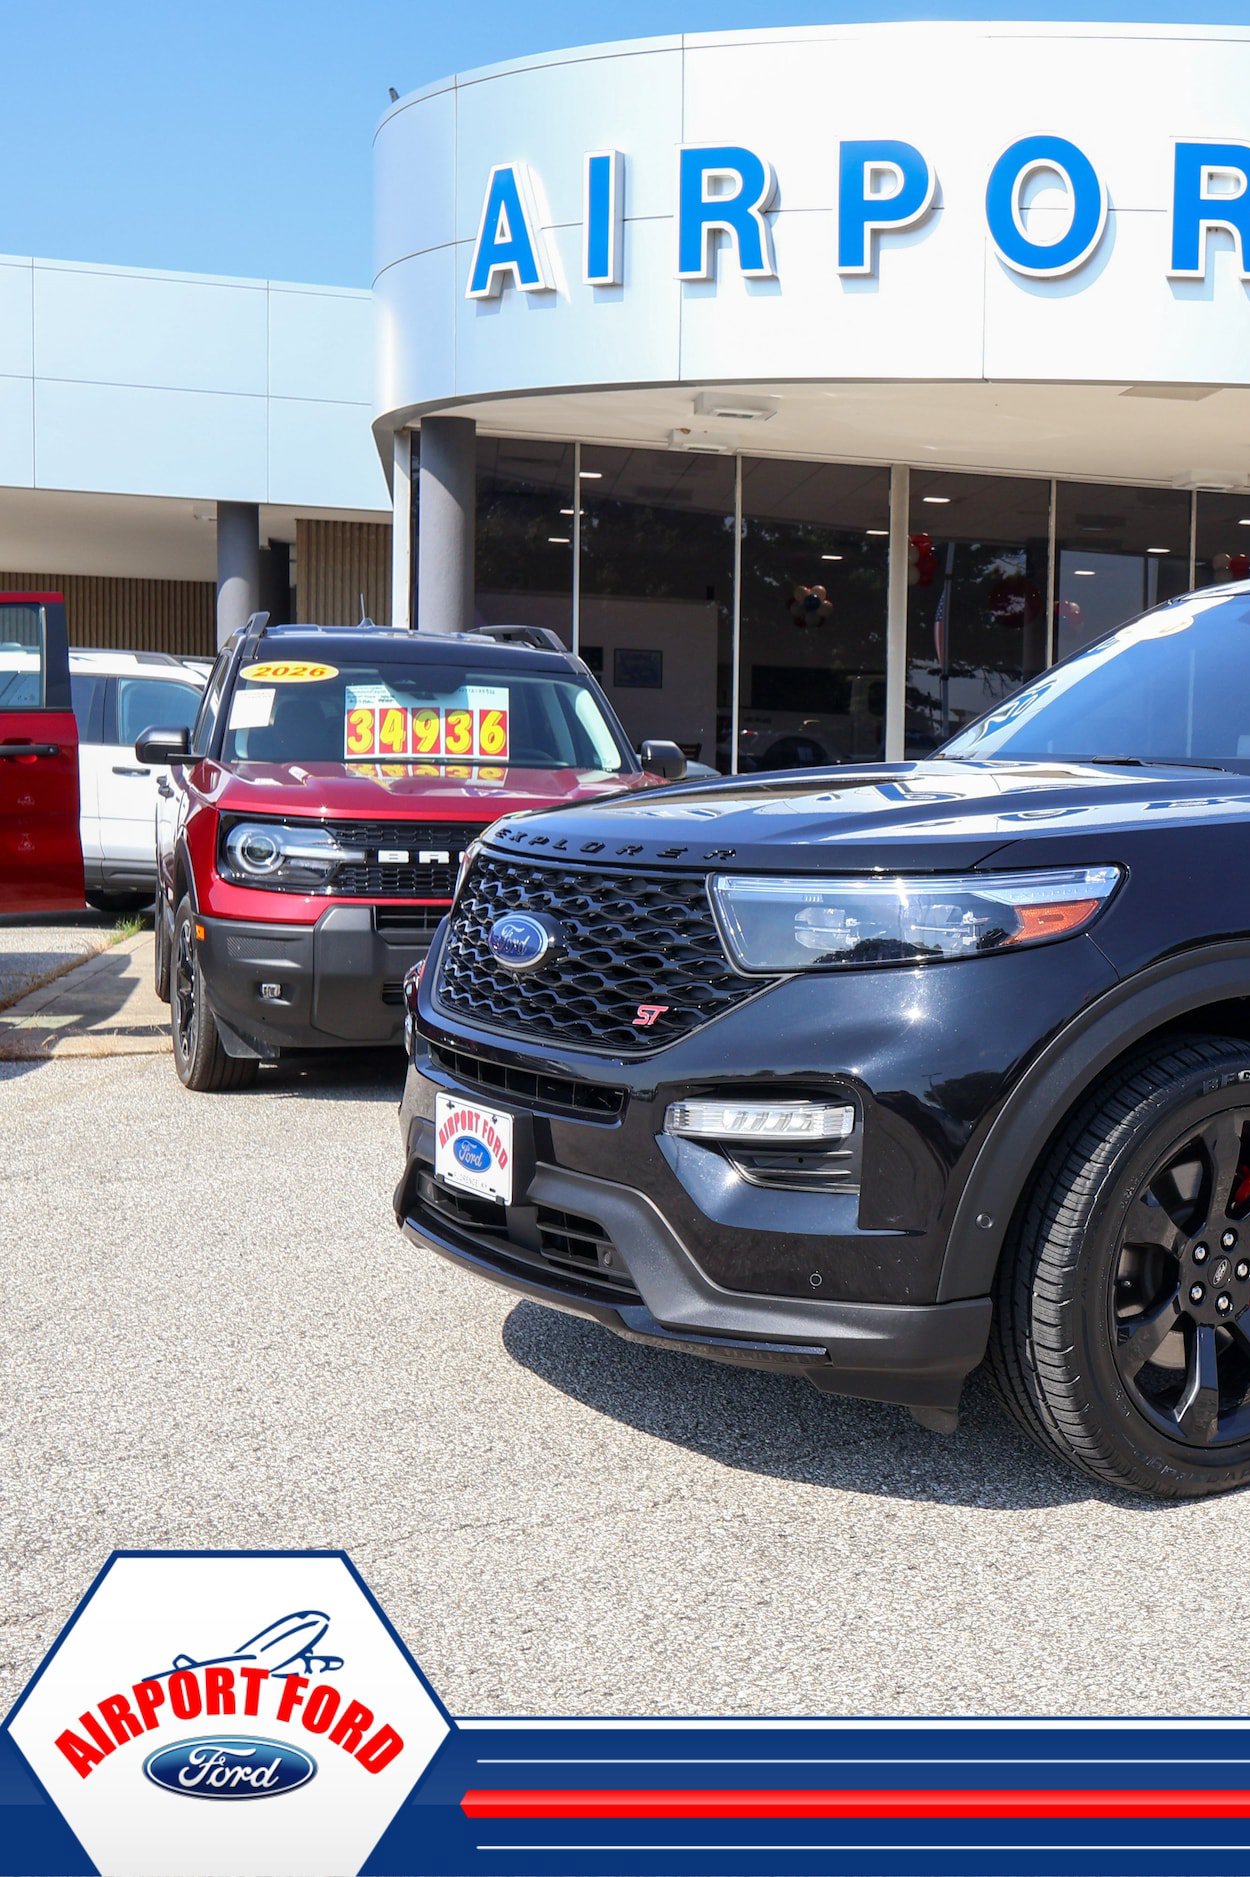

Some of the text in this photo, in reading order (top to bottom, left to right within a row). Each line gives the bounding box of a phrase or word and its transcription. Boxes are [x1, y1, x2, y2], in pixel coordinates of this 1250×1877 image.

[252, 666, 327, 677] 2026
[347, 709, 506, 754] 34936
[494, 828, 737, 861] EXPLORER
[493, 923, 529, 955] Ford
[632, 1004, 669, 1026] ST
[439, 1109, 508, 1170] AIRPORT FORD
[458, 1139, 484, 1168] Ford
